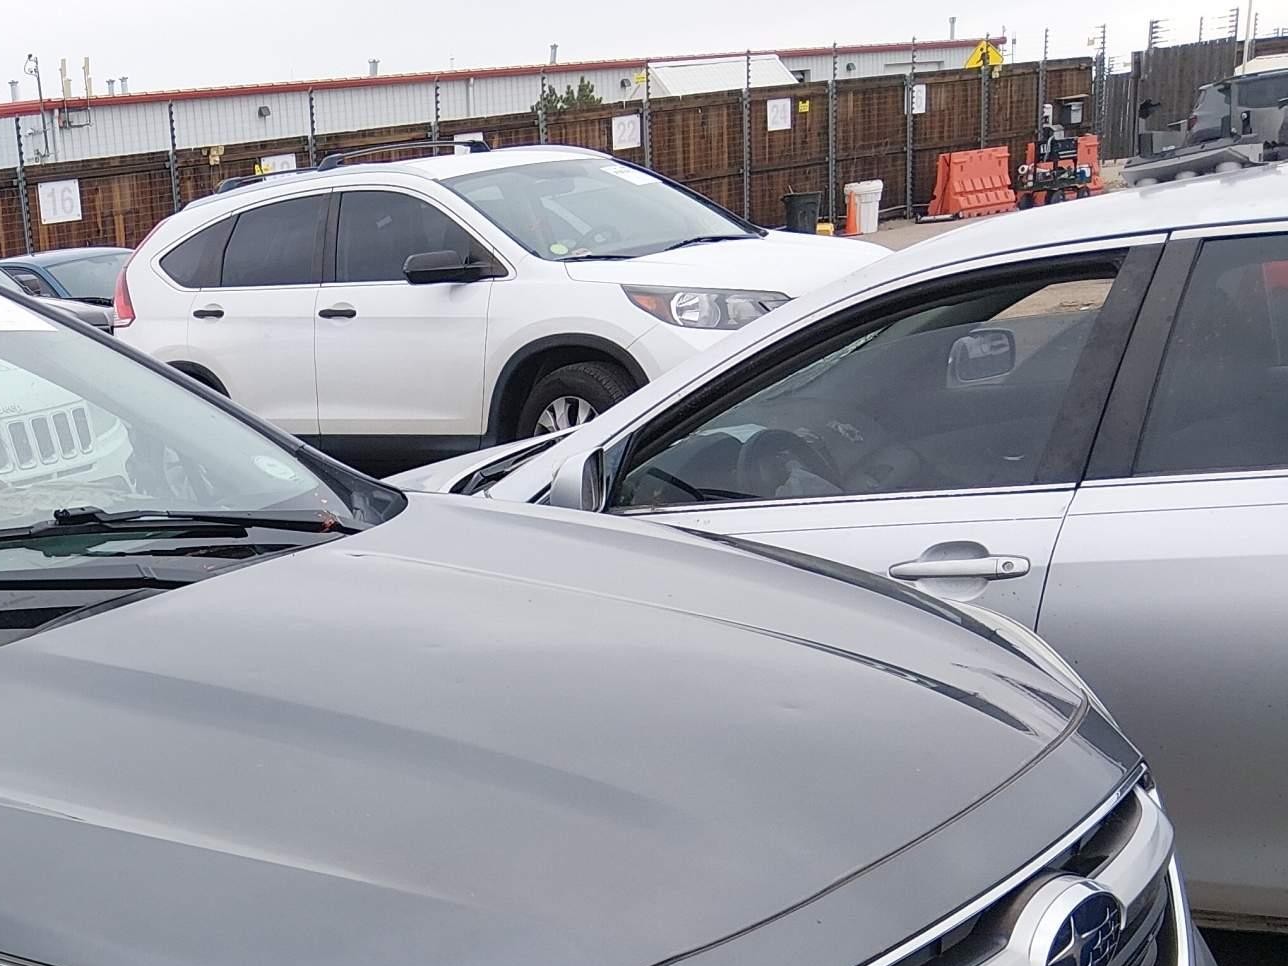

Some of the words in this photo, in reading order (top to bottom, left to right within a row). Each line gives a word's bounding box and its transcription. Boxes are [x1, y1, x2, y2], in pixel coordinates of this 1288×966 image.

[771, 103, 787, 125] 24
[618, 120, 636, 143] 22
[47, 187, 74, 216] 16
